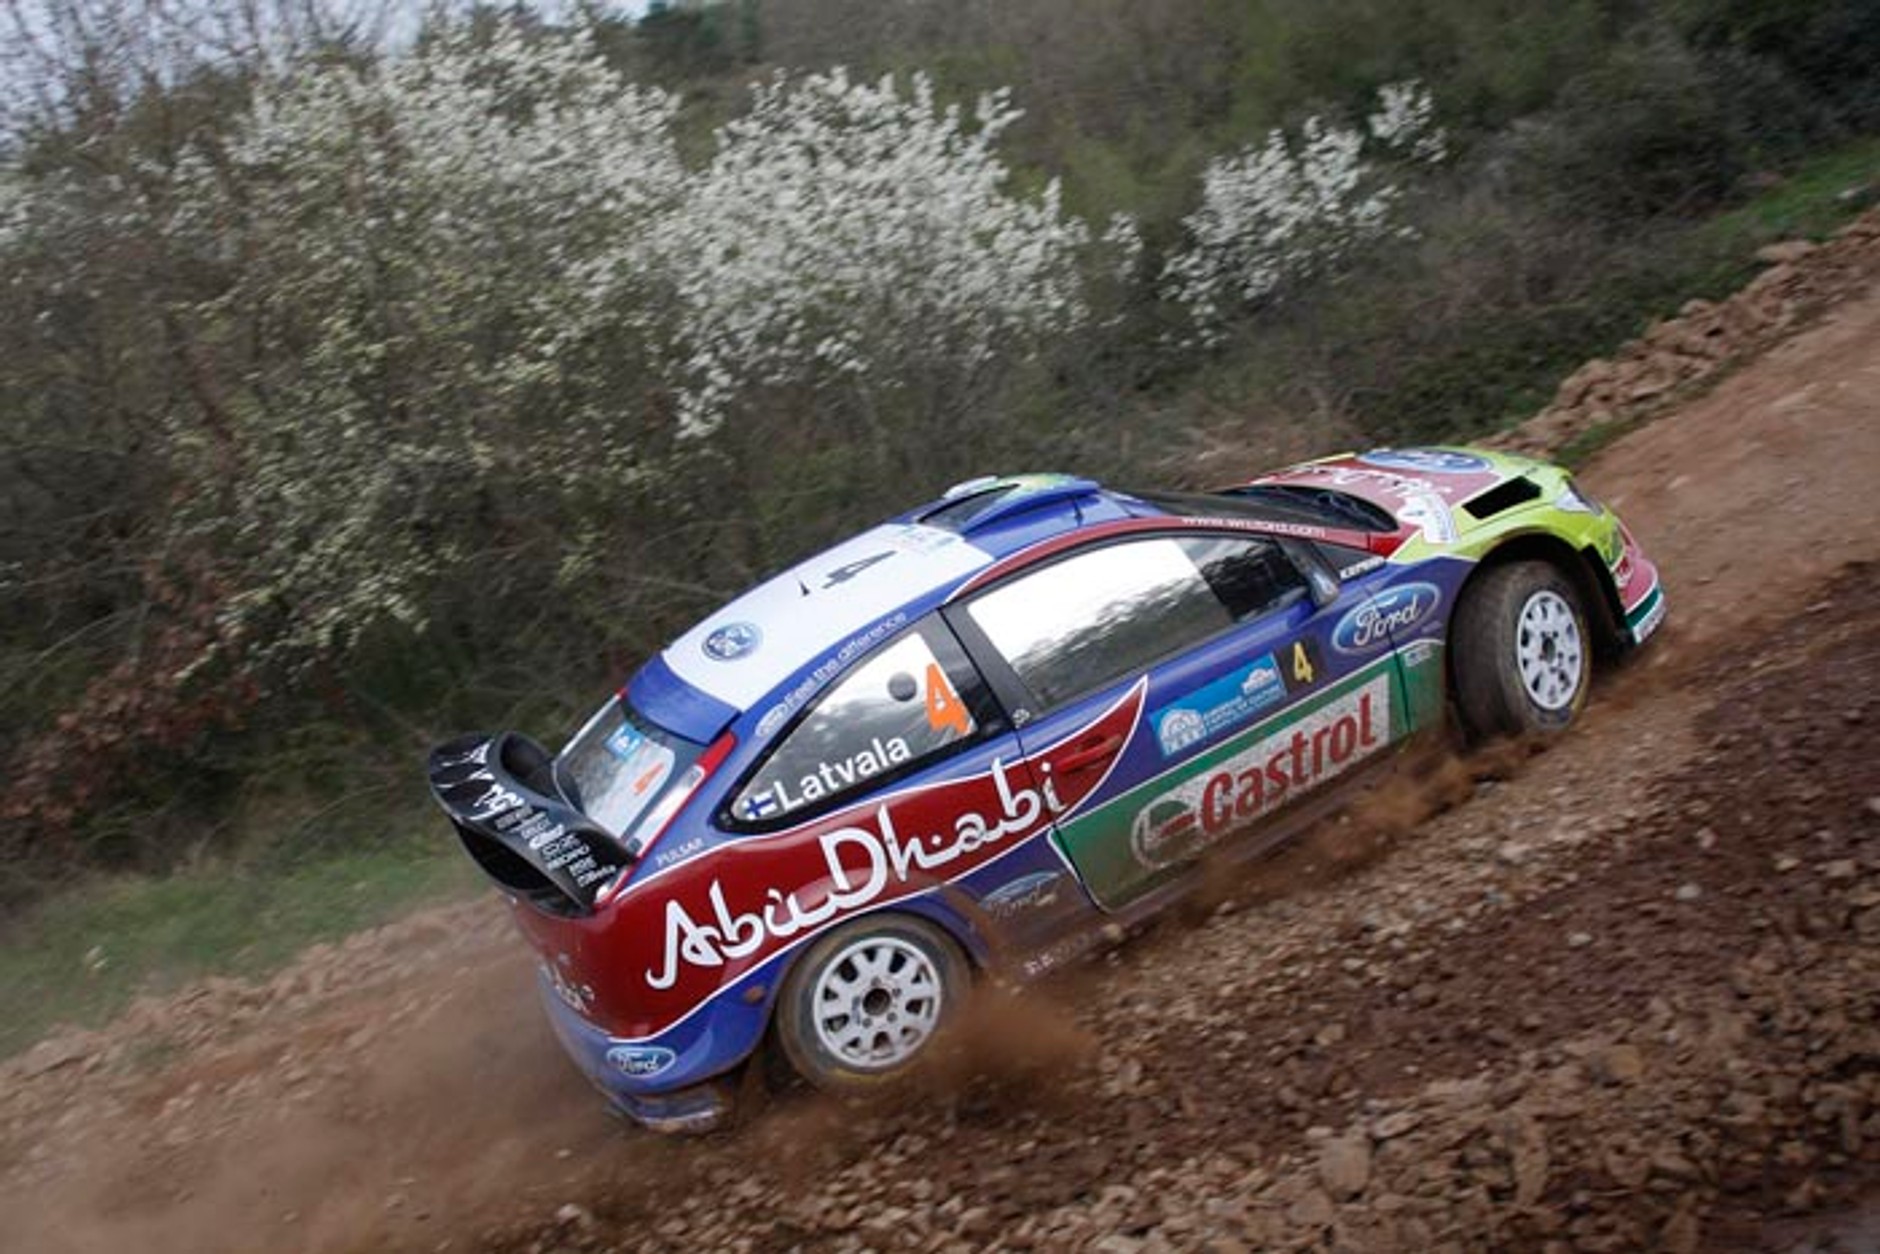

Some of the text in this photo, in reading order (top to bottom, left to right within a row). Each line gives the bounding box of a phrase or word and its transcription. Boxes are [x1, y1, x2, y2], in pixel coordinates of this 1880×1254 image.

[1354, 593, 1421, 646] Ford
[926, 662, 970, 734] 4
[1294, 642, 1313, 683] 4
[774, 736, 911, 812] Latvala
[1202, 692, 1376, 835] Castrol
